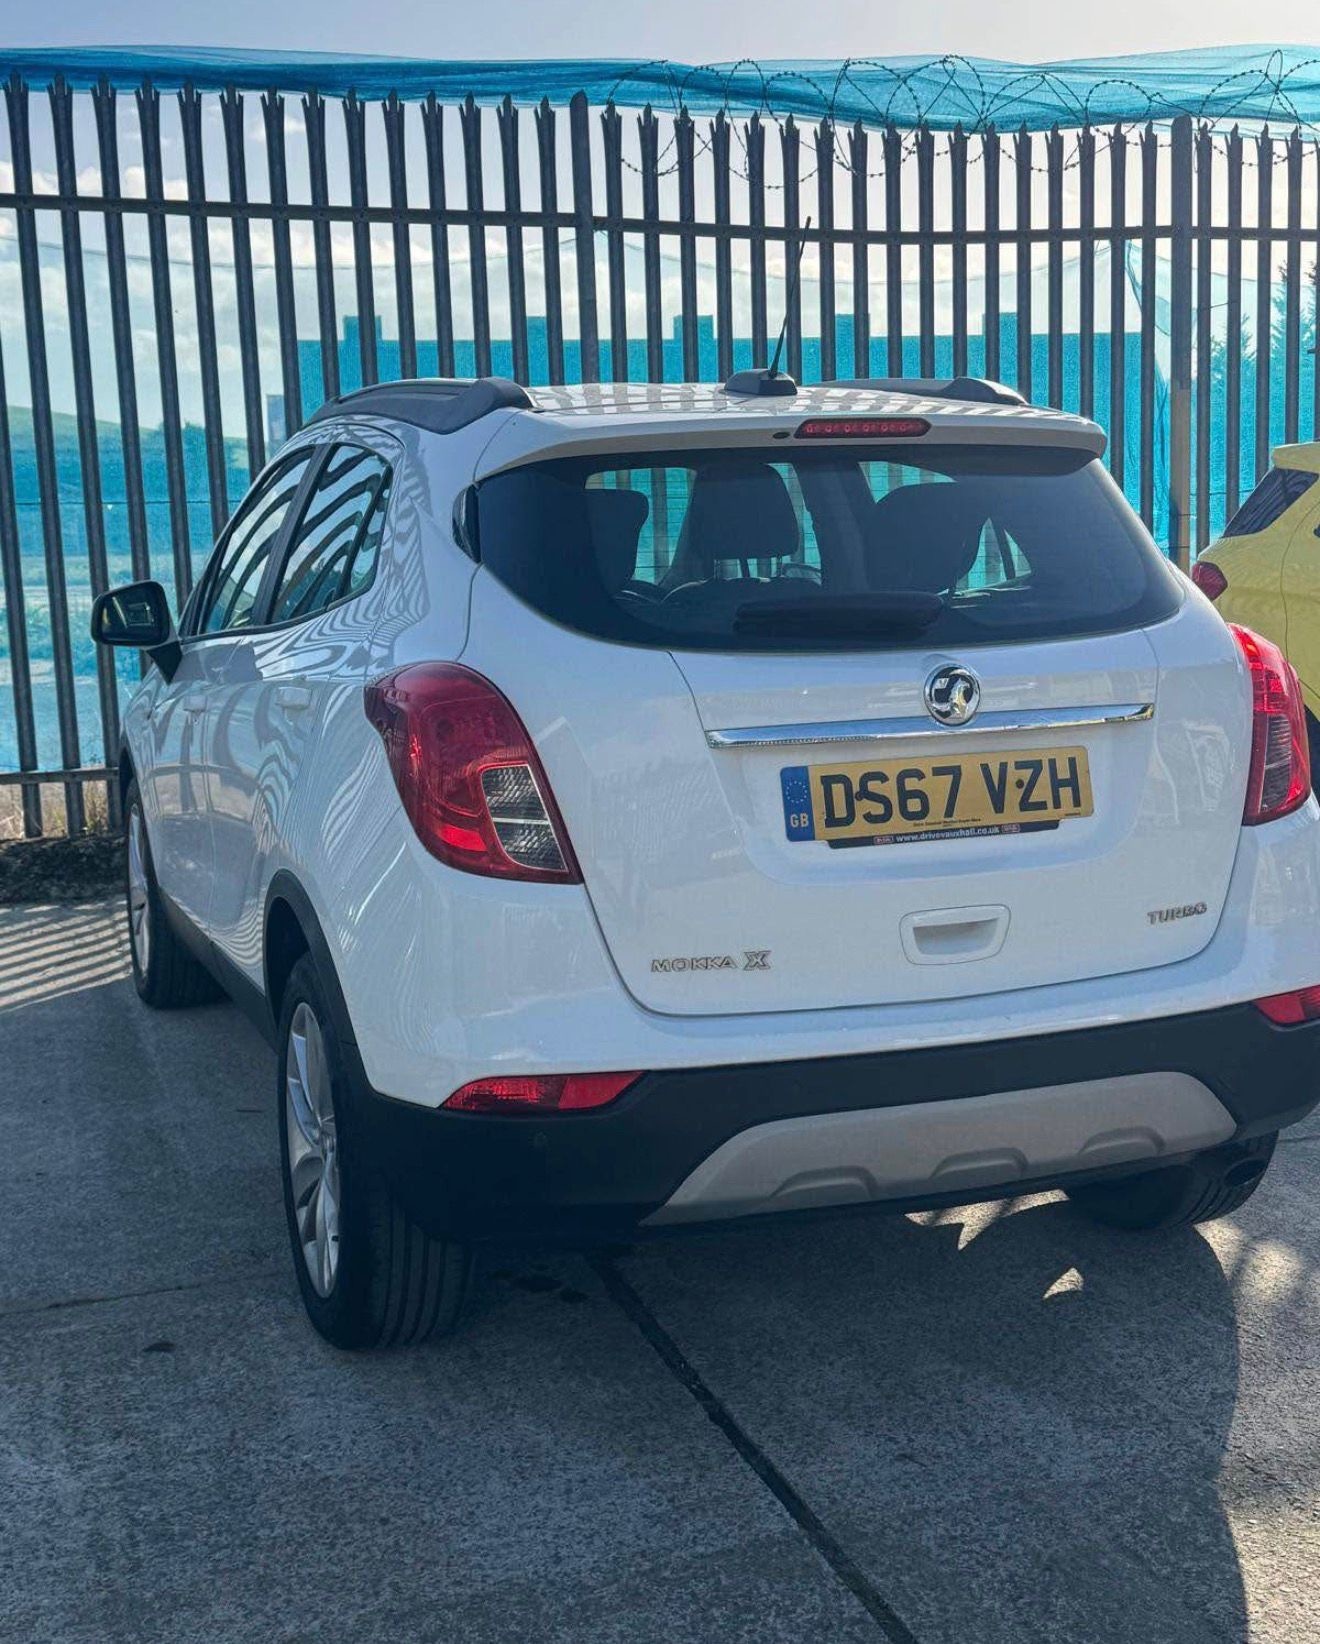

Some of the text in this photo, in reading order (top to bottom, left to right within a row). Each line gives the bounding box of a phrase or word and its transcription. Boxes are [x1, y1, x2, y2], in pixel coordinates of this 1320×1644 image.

[820, 757, 1081, 828] DS67 VZH
[790, 812, 809, 828] GB
[896, 825, 1000, 843] www.drivevauxhall.co.uk
[1147, 902, 1207, 925] TURBO
[651, 950, 771, 973] MOKKA X
